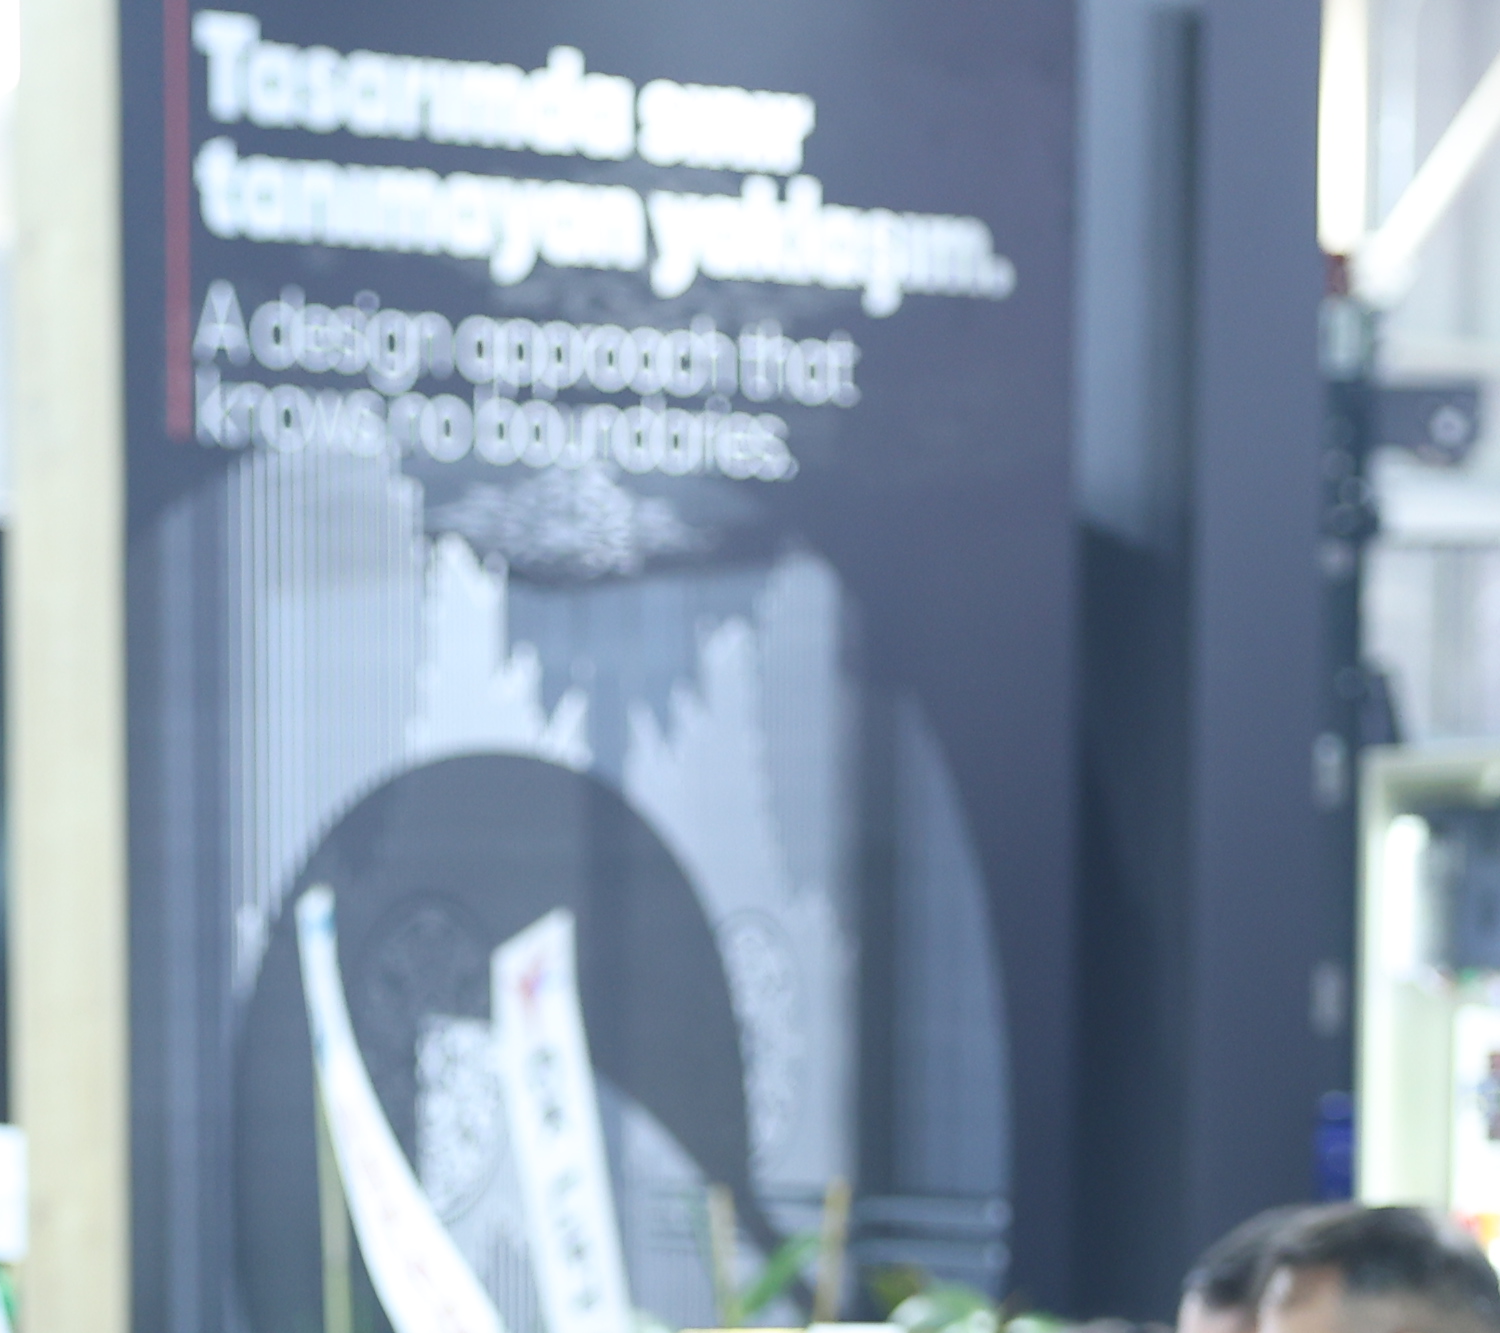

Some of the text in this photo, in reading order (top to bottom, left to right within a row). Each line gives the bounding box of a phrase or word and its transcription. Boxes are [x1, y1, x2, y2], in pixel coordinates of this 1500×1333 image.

[194, 280, 860, 408] A design approach that
[195, 364, 389, 458] knows
